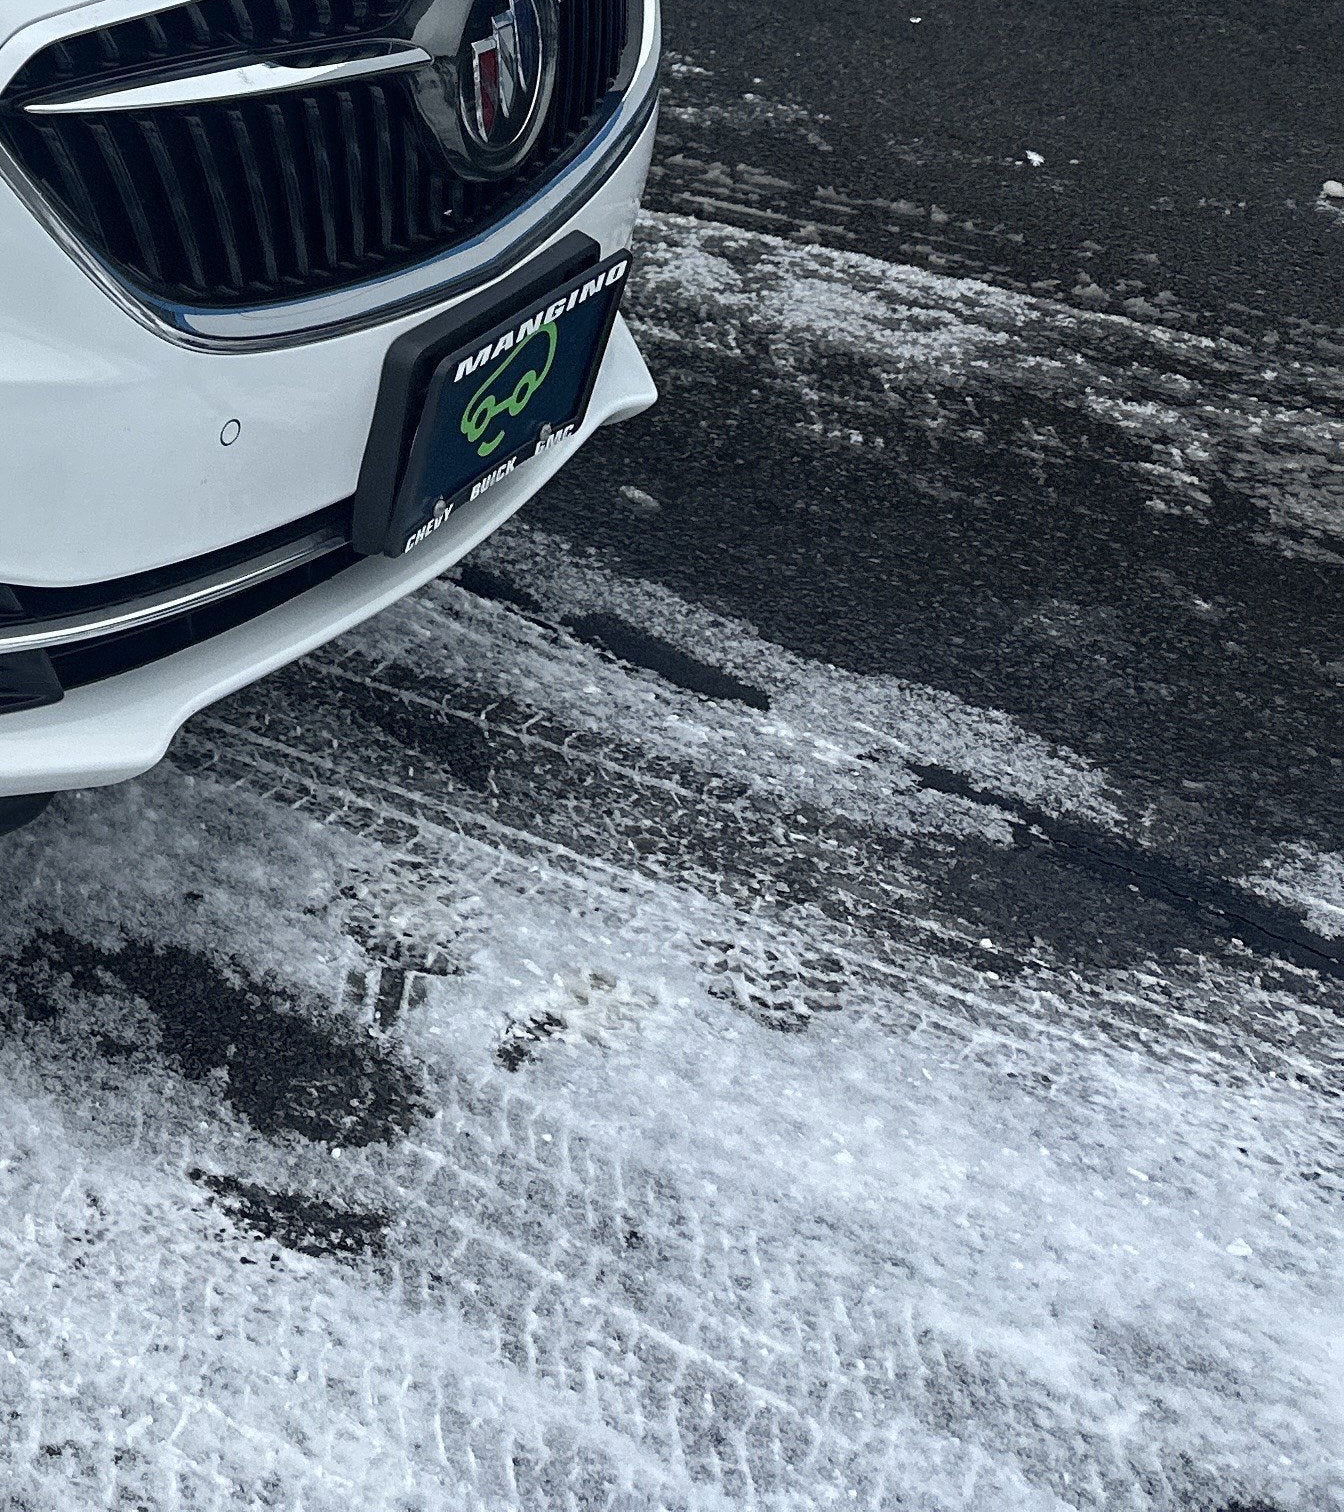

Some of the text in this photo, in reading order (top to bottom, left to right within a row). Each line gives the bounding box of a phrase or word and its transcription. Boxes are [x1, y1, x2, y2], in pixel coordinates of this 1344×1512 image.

[453, 259, 628, 383] MANGINO
[404, 423, 576, 554] CHEVY BUICK GMC
